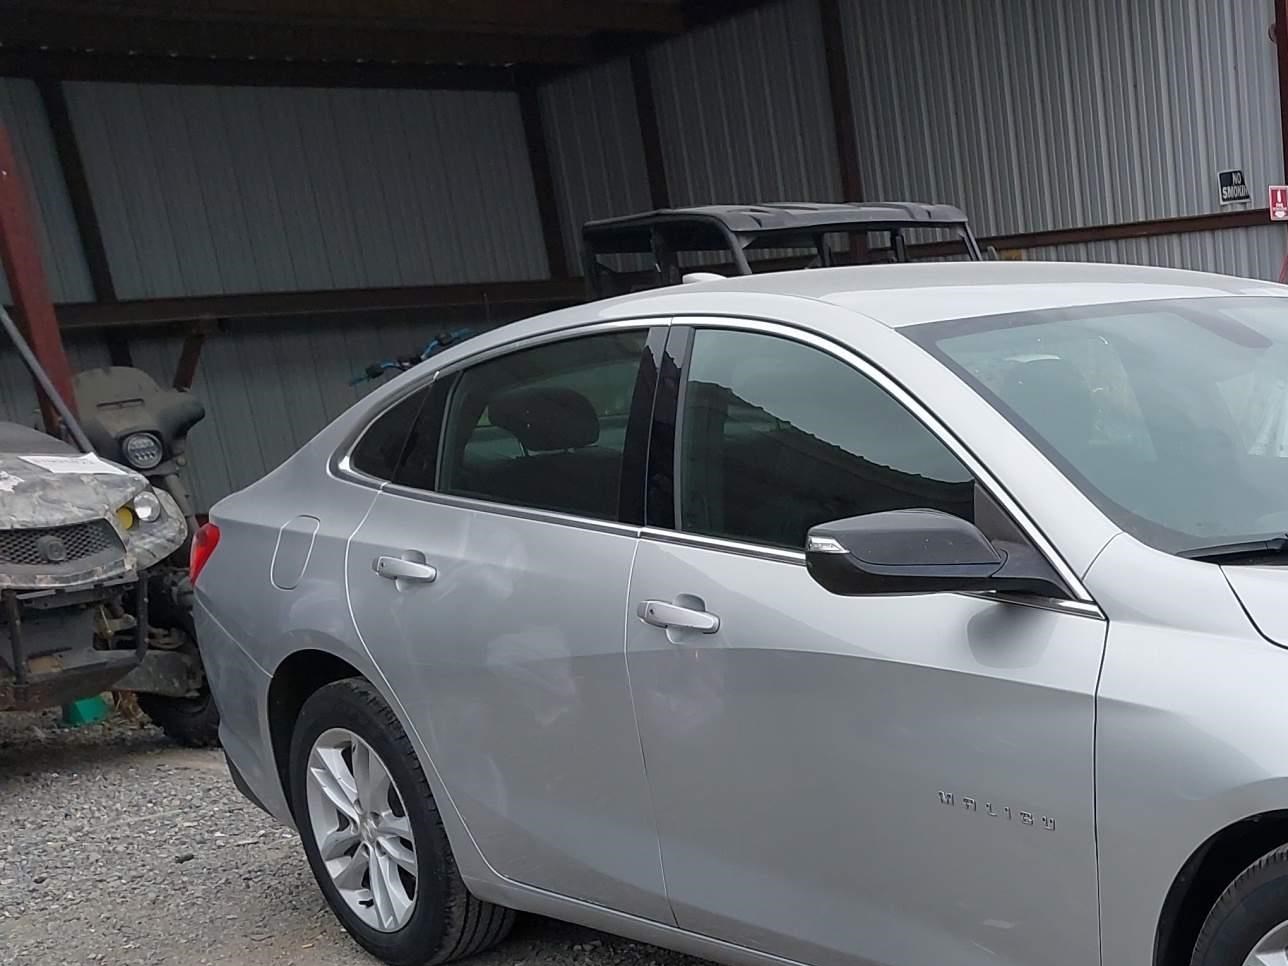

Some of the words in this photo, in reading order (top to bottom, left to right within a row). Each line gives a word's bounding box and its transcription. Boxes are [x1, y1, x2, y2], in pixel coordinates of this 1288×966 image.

[1232, 172, 1241, 185] NO
[1222, 185, 1249, 199] SMOKIN
[937, 790, 1056, 831] MALIBU
